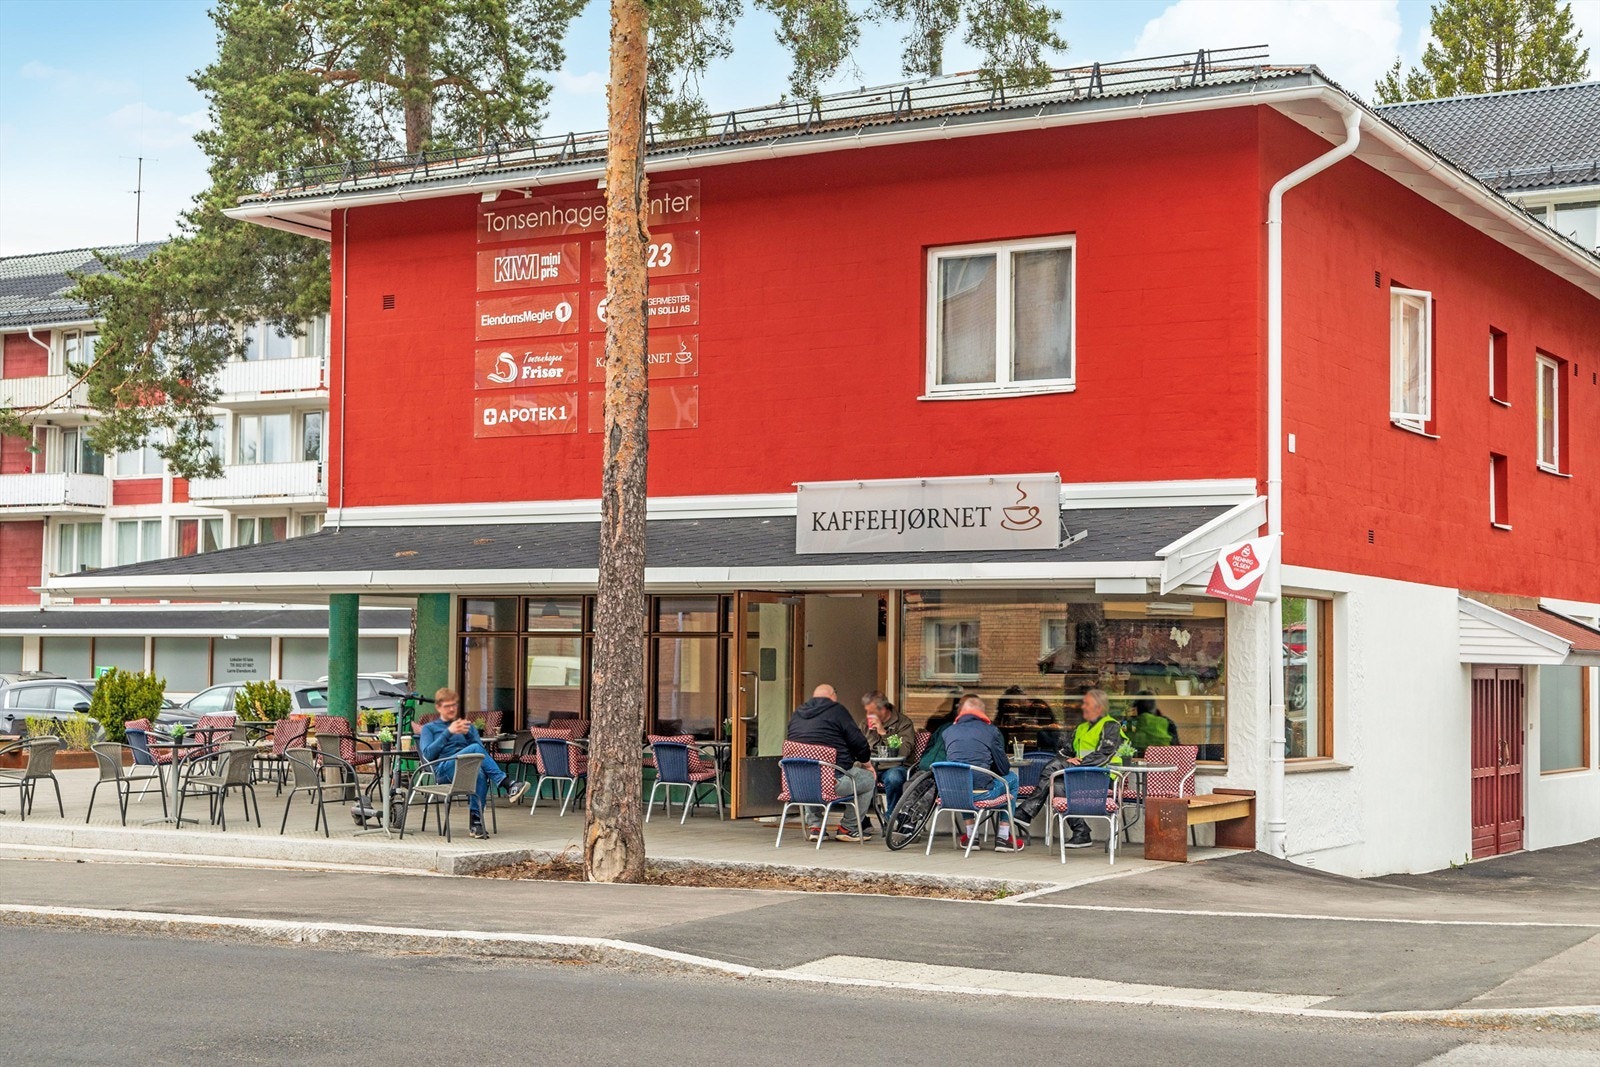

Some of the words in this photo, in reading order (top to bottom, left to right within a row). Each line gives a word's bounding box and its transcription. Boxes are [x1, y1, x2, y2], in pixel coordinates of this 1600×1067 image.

[483, 204, 606, 233] Tonsenhage
[650, 192, 693, 215] nter
[541, 252, 561, 266] mini
[494, 253, 540, 283] KIWI
[540, 265, 559, 281] pris
[647, 295, 690, 306] GERMESTER
[657, 306, 678, 315] SOLLI
[679, 304, 691, 313] AS
[481, 309, 555, 326] EiendomsMegler
[521, 365, 564, 379] Frisør
[498, 406, 557, 423] APOTEK
[558, 405, 567, 420] 1
[812, 505, 991, 535] KAFFEHJØRNET
[1232, 555, 1254, 565] HENNIG
[1232, 561, 1250, 570] OLSEN
